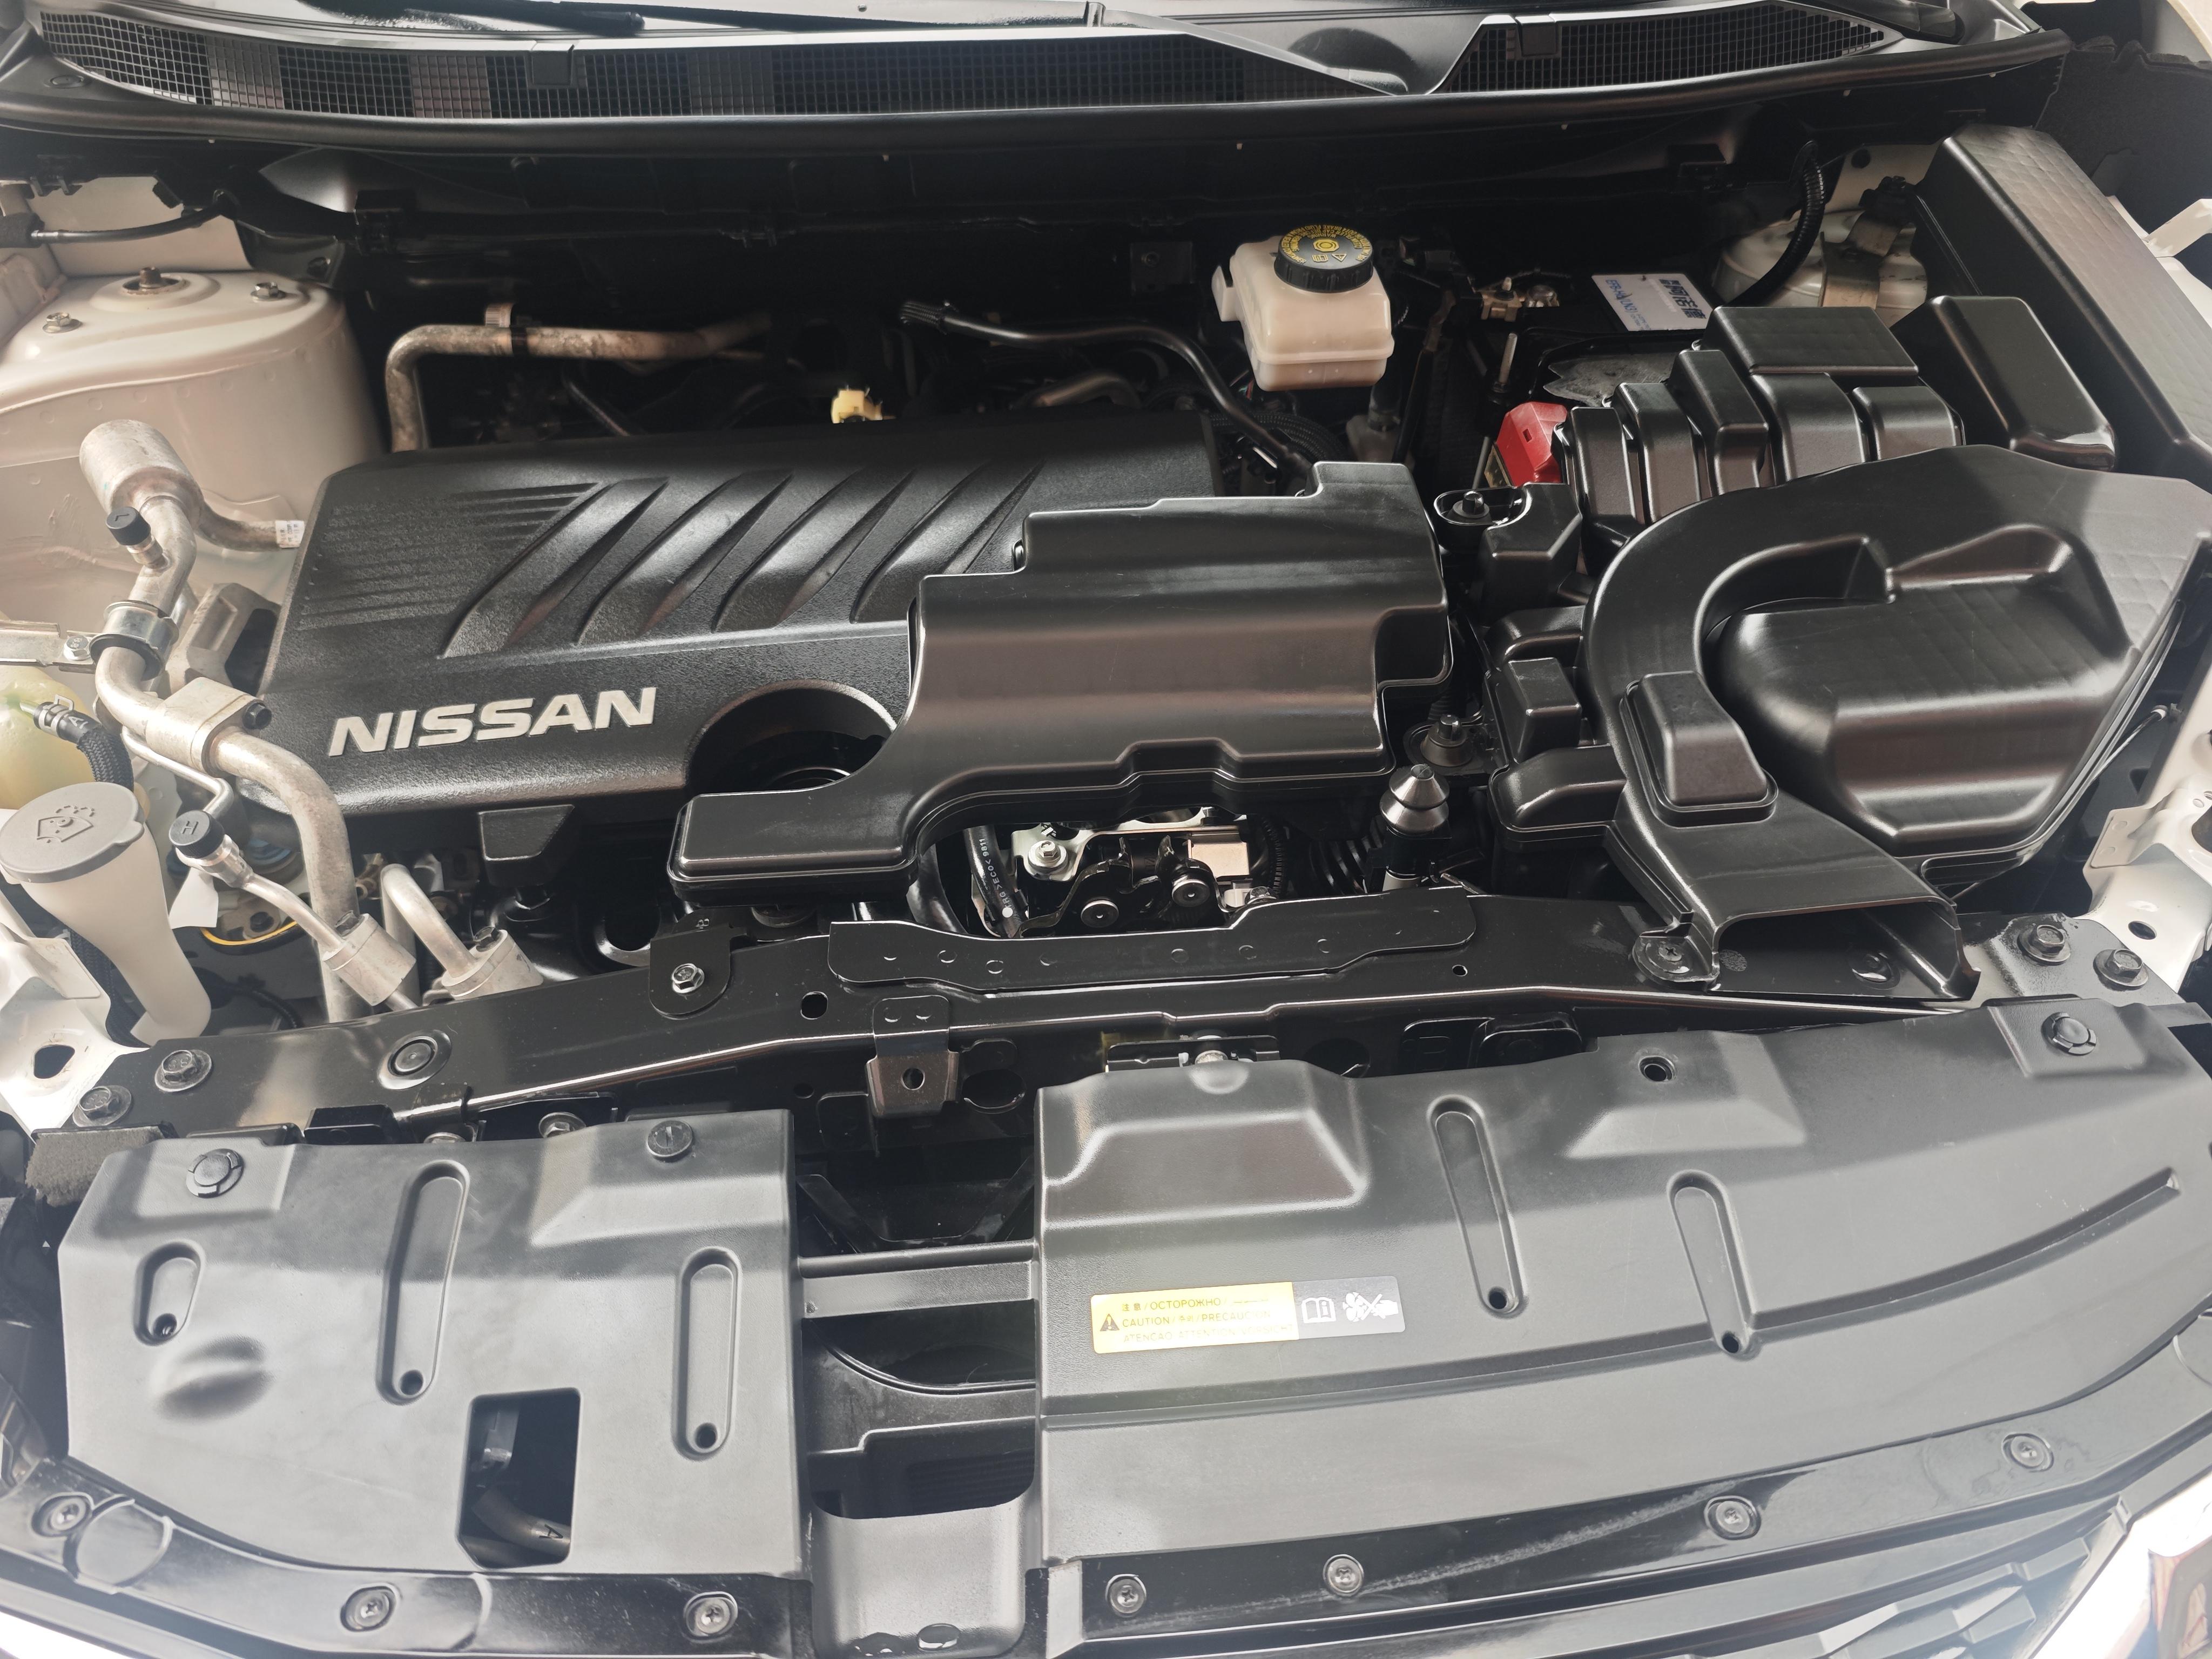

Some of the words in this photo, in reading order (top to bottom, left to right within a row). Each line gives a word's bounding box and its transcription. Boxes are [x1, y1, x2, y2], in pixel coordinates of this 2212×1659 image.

[328, 686, 657, 757] NISSAN
[181, 820, 199, 835] H
[979, 839, 989, 857] 9811
[1150, 1298, 1221, 1310] ОСТОРОЖНО
[1122, 1317, 1170, 1327] CAUTION
